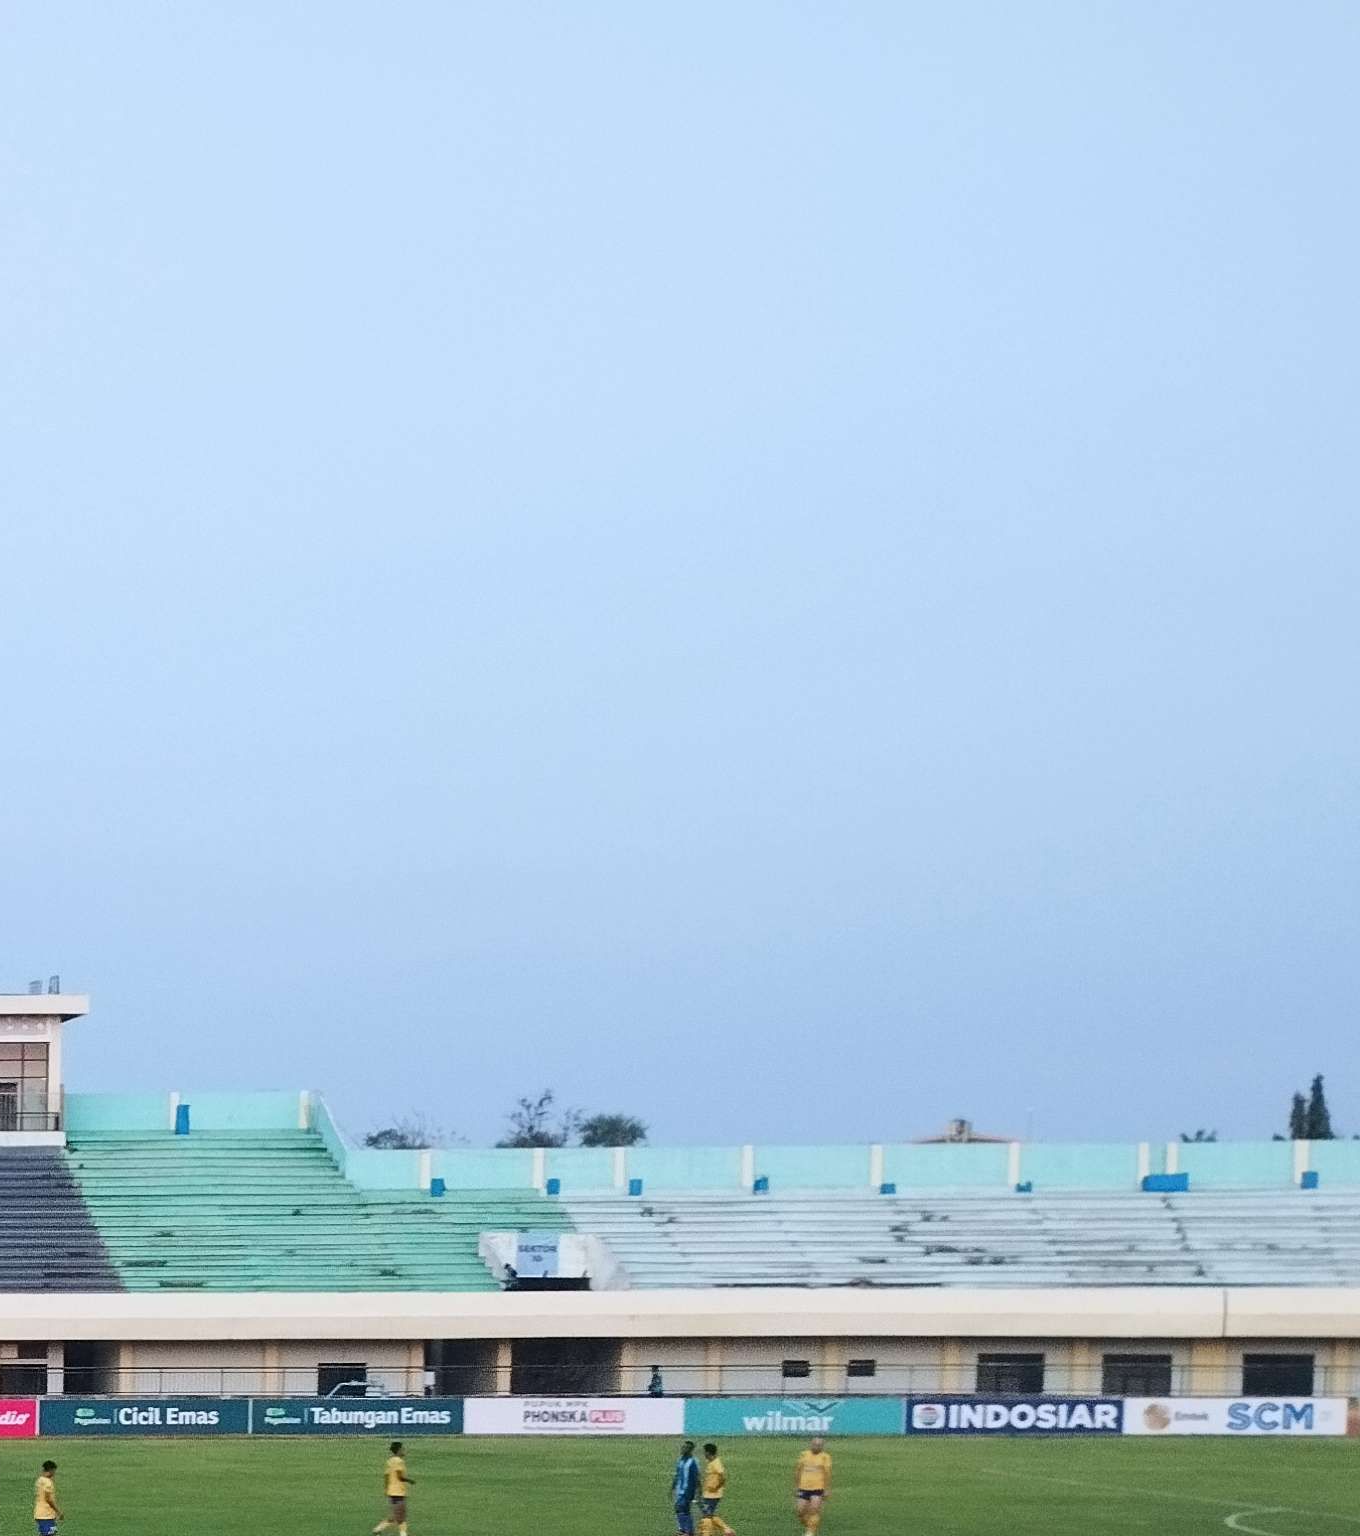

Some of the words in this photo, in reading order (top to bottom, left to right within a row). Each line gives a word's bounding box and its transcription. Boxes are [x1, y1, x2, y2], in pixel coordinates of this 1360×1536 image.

[118, 1407, 162, 1424] Cicil
[166, 1408, 219, 1425] Emas
[309, 1407, 399, 1428] Tabungan
[400, 1407, 451, 1424] Emas
[742, 1411, 833, 1432] wilmar
[948, 1403, 1117, 1430] INDOSIAR
[1226, 1402, 1314, 1431] SCM
